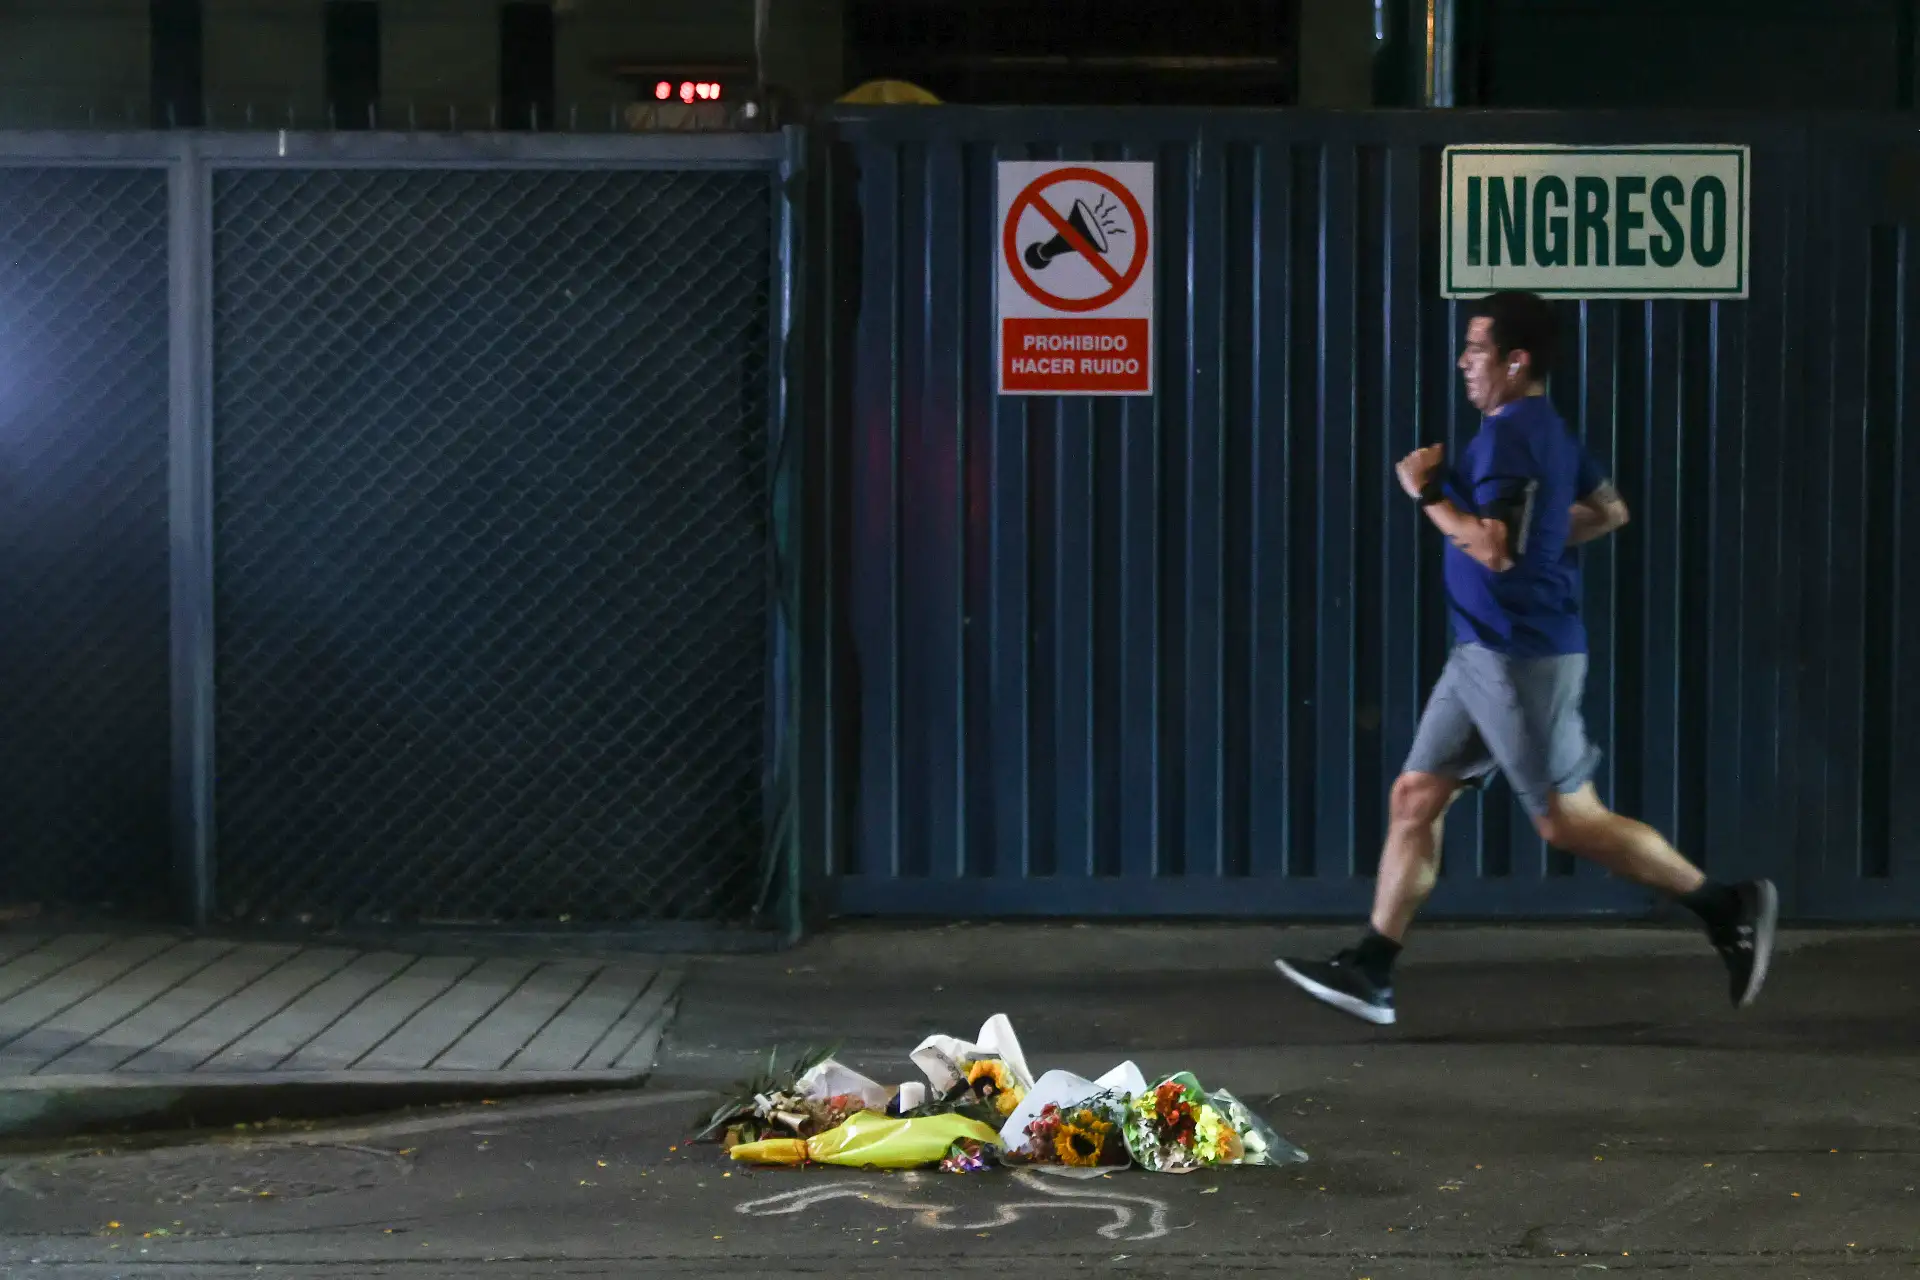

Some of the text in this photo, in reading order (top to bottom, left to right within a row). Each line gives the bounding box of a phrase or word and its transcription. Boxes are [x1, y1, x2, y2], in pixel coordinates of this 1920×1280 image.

[1467, 175, 1727, 268] INGRESO
[1023, 334, 1128, 351] PROHIBIDO
[1011, 358, 1139, 375] HACER RUIDO
